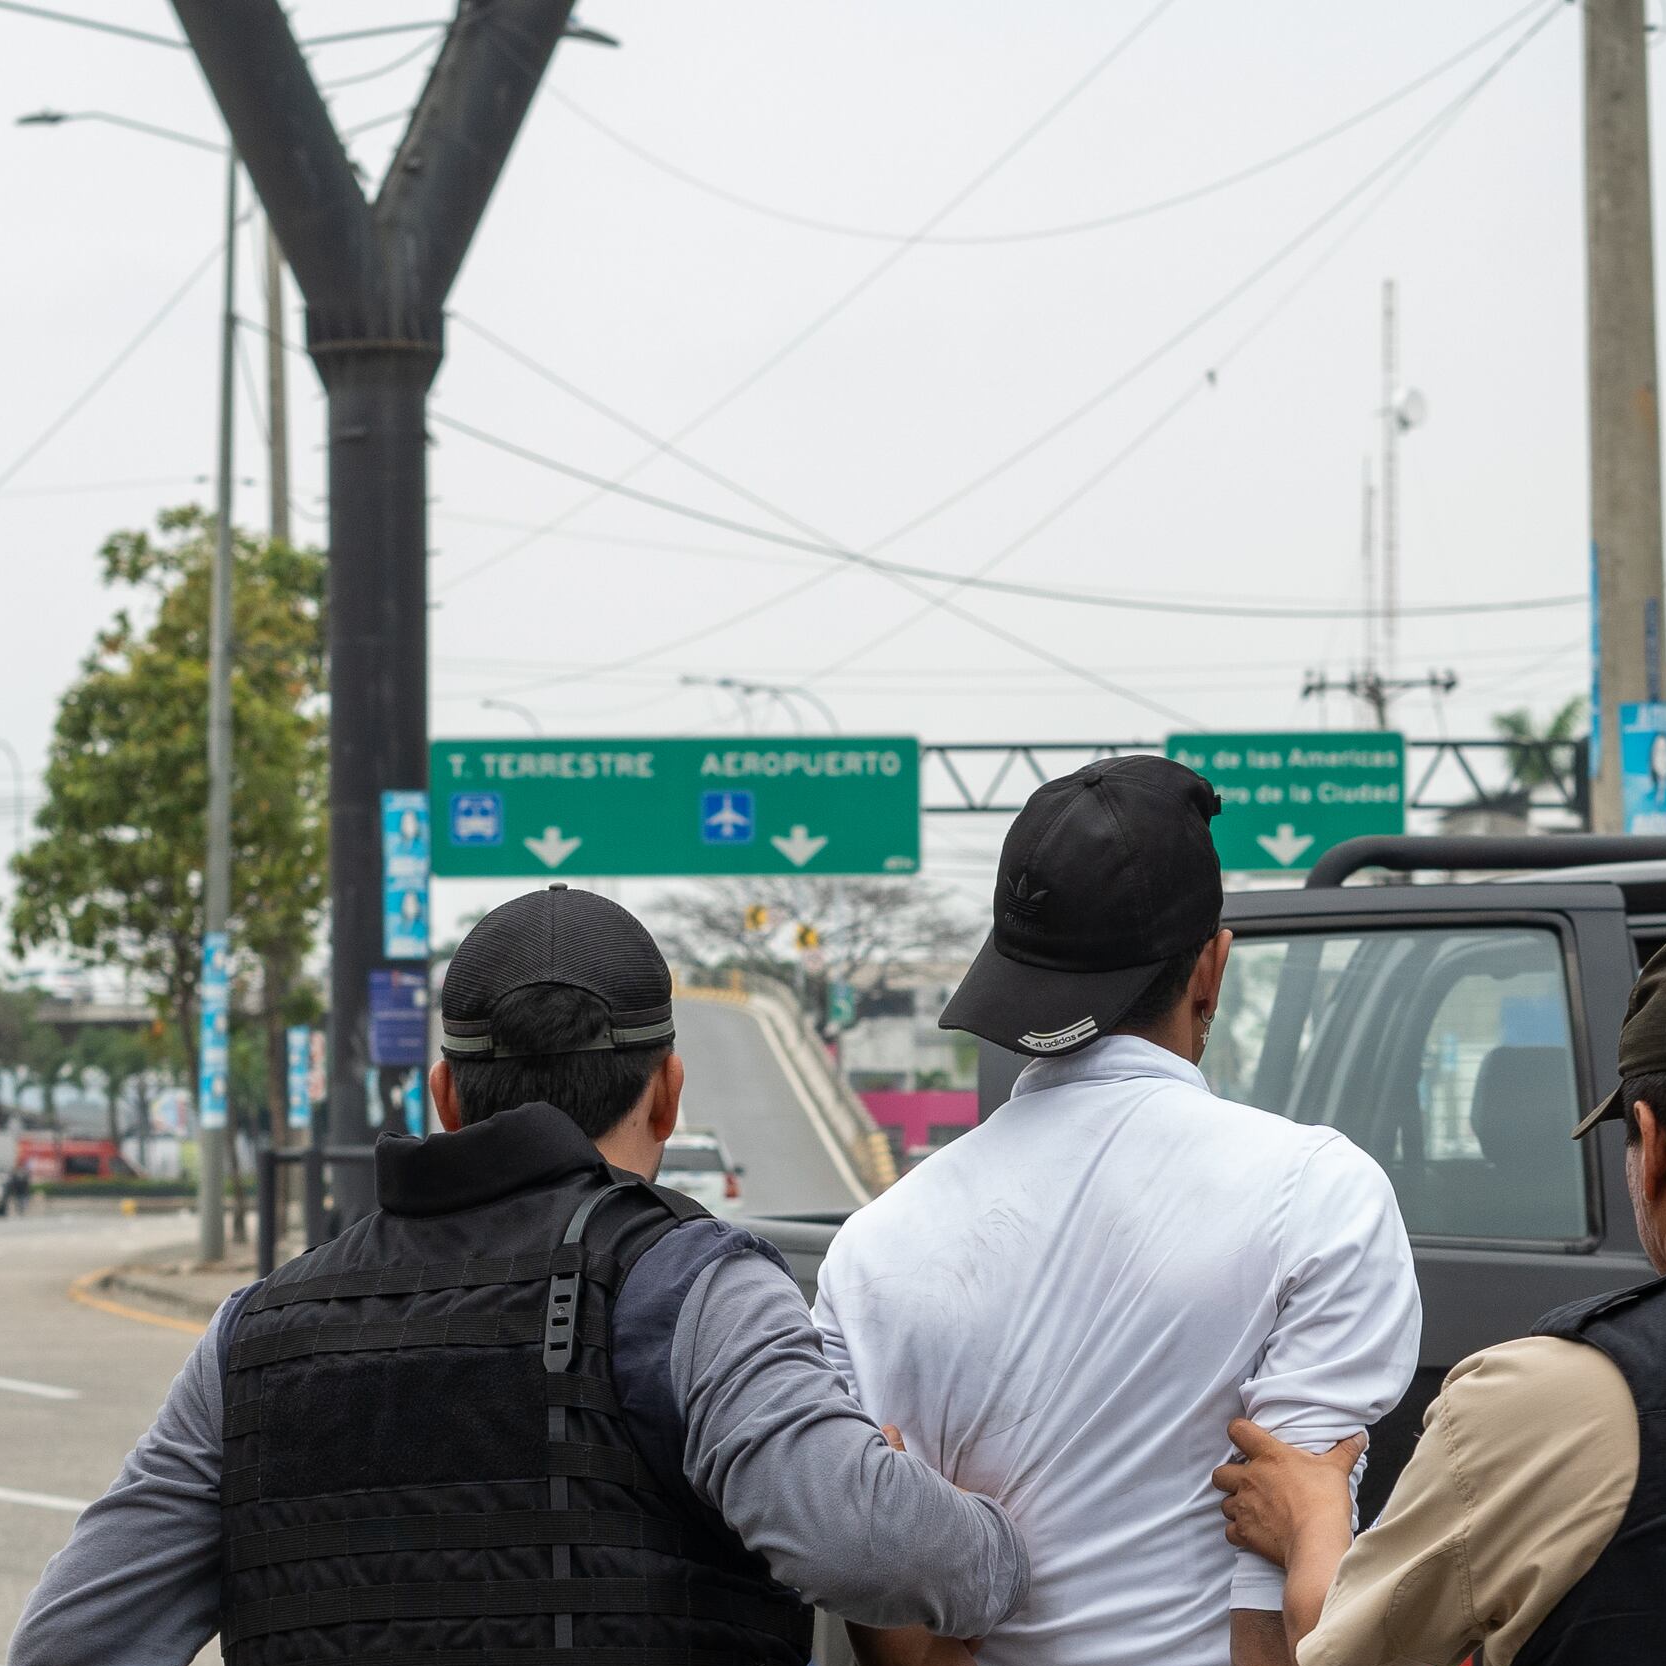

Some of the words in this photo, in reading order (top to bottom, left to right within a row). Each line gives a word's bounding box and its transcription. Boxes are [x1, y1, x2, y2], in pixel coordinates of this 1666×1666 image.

[481, 752, 655, 779] TERRESTRE
[700, 751, 901, 778] AEROPUERTO
[1212, 750, 1241, 769] de
[1246, 749, 1282, 769] las
[1287, 748, 1398, 768] Americas
[1215, 784, 1251, 804] tro
[1255, 784, 1283, 804] de
[1289, 784, 1312, 804] la
[1317, 782, 1400, 804] Ciudad
[1043, 1033, 1077, 1049] adidas
